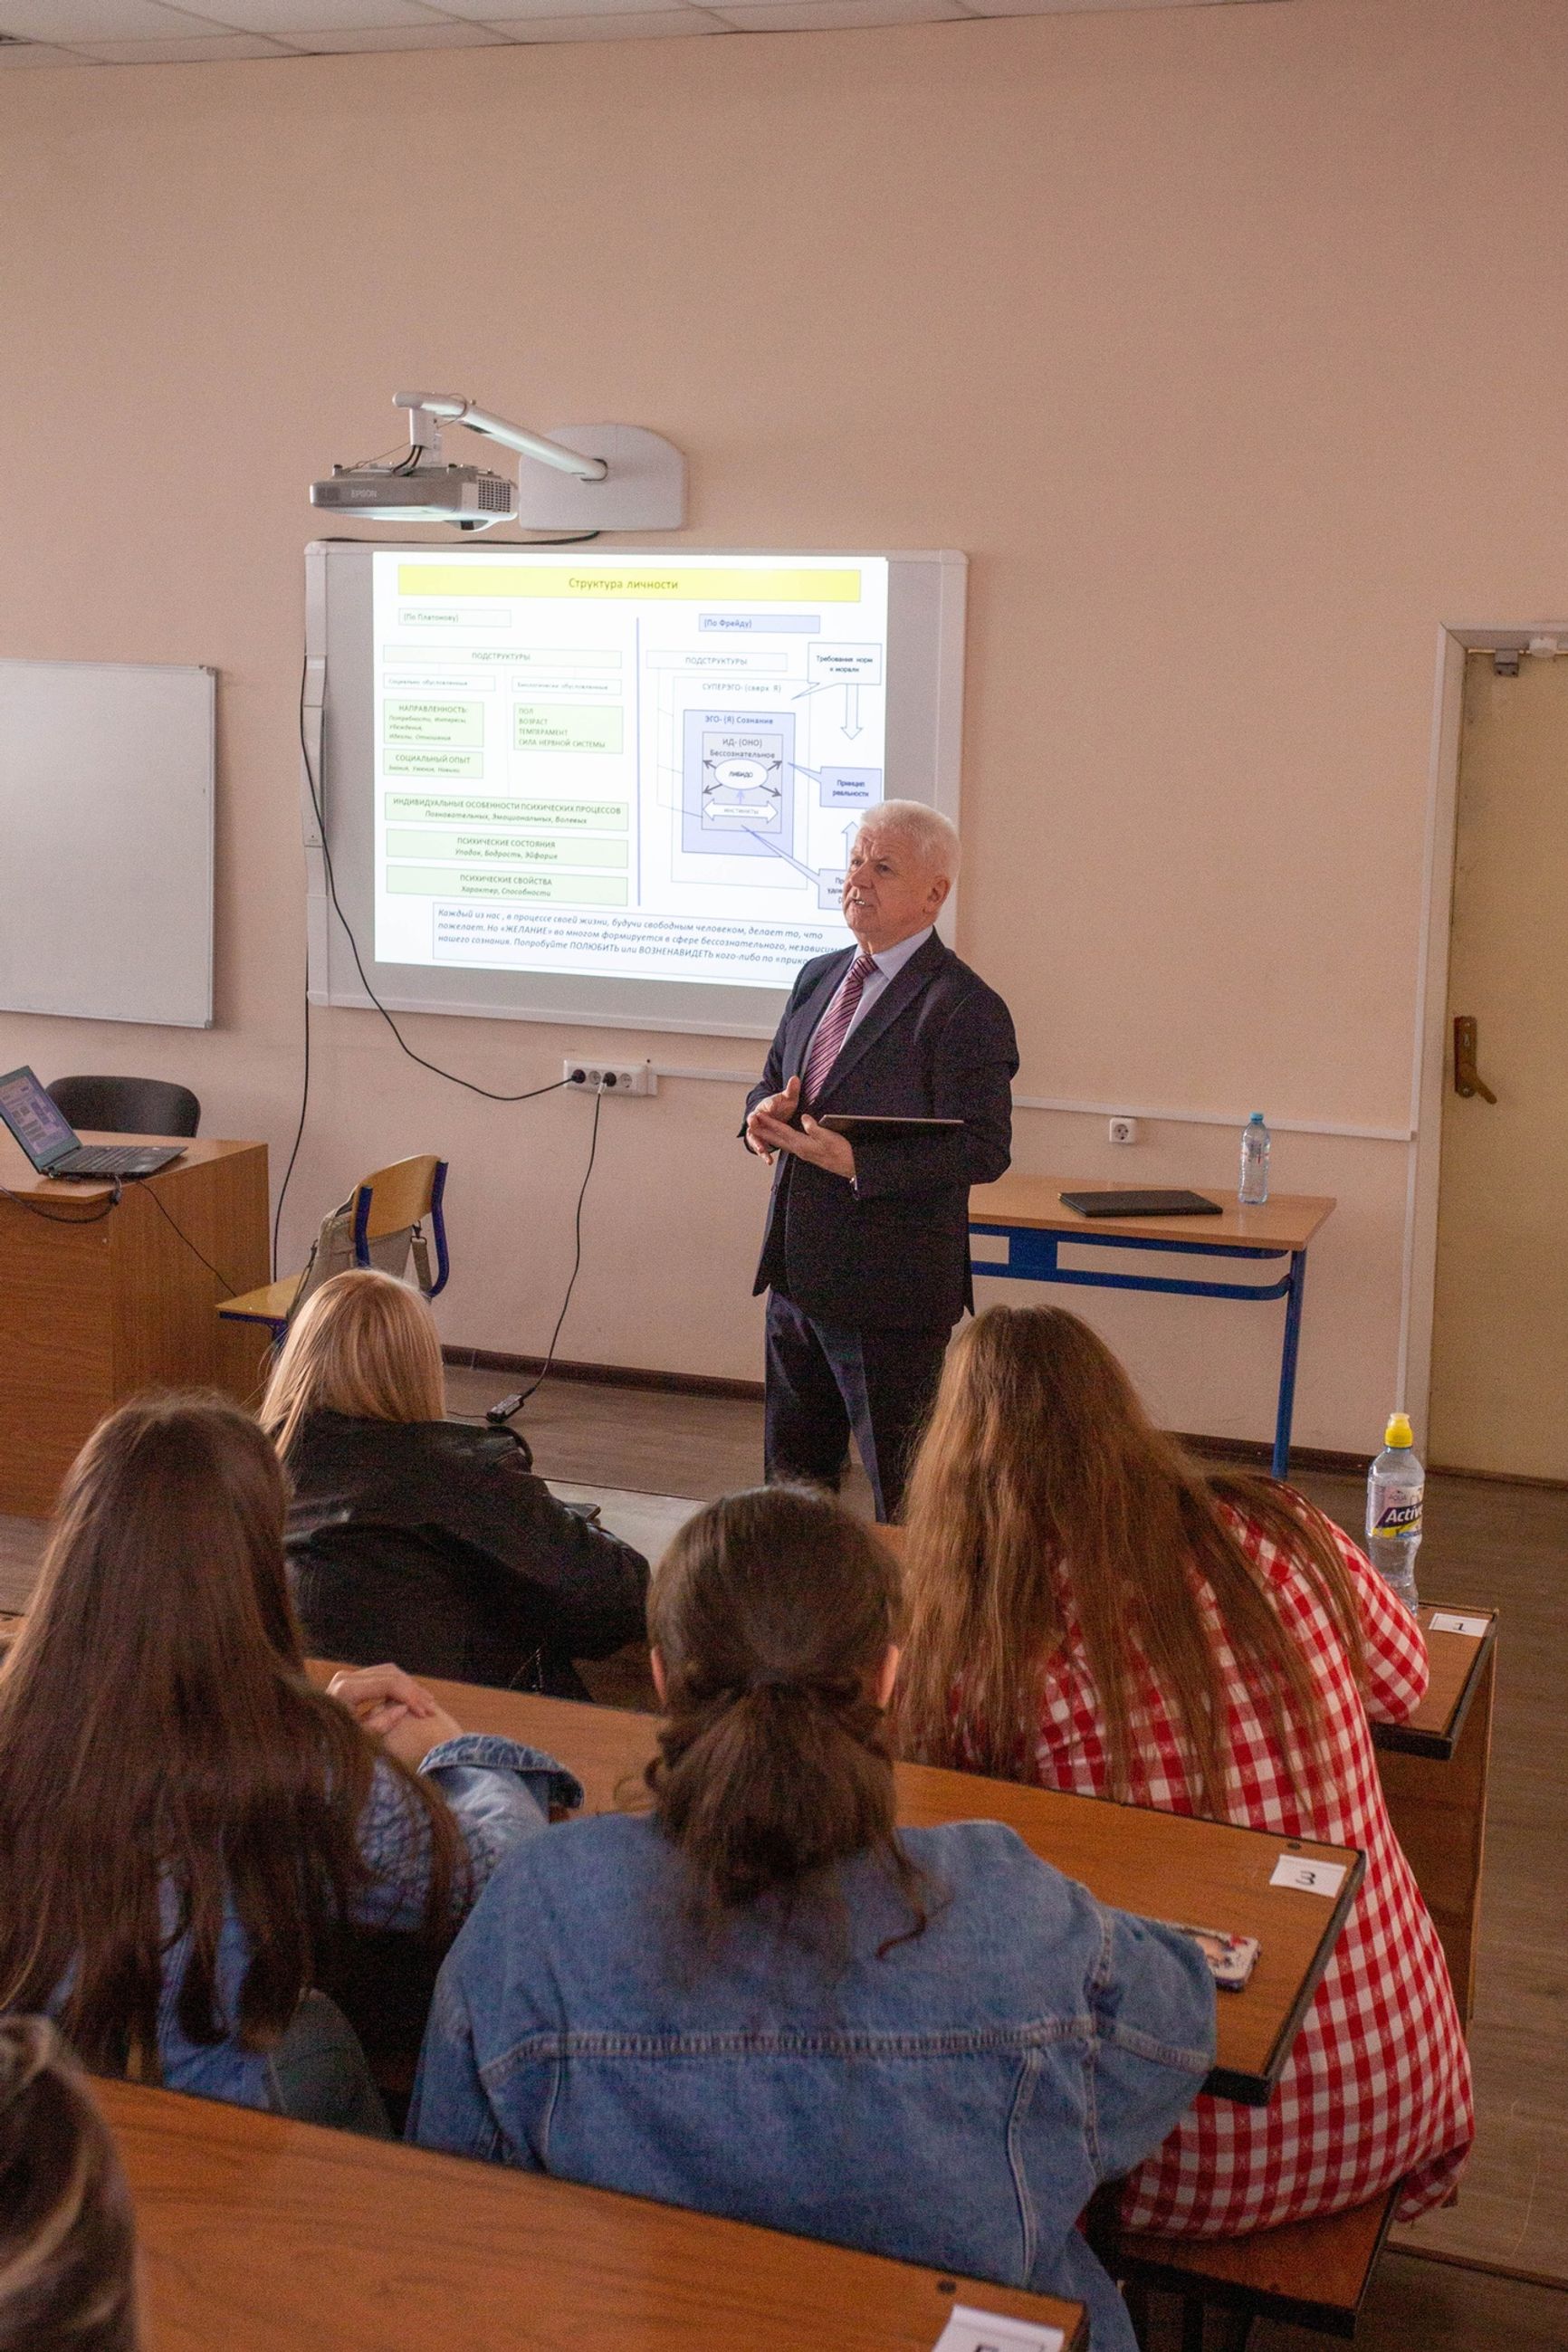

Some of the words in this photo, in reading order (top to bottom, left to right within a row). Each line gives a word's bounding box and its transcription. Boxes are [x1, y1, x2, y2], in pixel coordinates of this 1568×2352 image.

[351, 489, 377, 498] EPSON
[569, 578, 623, 590] Структура
[626, 580, 679, 589] личности
[703, 618, 718, 628] (По
[719, 618, 752, 629] Фрейду)
[472, 652, 531, 661] ПОДСТРУКТУРЫ
[685, 656, 748, 665] ПОДСТРУКТУРЫ
[817, 655, 854, 664] Требования
[736, 716, 773, 725] Сознание
[519, 728, 568, 736] ТЕМПЕРАМЕНТ
[519, 739, 537, 747] СИЛА
[539, 739, 570, 747] НЕРВНОЙ
[572, 741, 606, 749] СИСТЕМЫ
[396, 754, 448, 764] СОЦИАЛЬНЫЙ
[450, 756, 471, 764] ОПЫТ
[710, 750, 775, 760] Бессознательное
[837, 779, 865, 788] Принцип
[832, 789, 869, 798] реальности
[393, 798, 464, 808] ИНДИВИДУАЛЬНЫЕ
[465, 800, 520, 810] ОСОБЕННОСТИ
[521, 803, 574, 812] ПСИХИЧЕСКИХ
[576, 806, 621, 815] ПРОЦЕССОВ
[457, 837, 509, 846] ПСИХИЧЕСКИЕ
[511, 839, 556, 848] СОСТОЯНИЯ
[460, 875, 512, 884] ПСИХИЧЕСКИЕ
[513, 875, 552, 885] СВОЙСТВА
[438, 909, 473, 918] Каждый
[513, 914, 552, 923] процессе
[553, 913, 578, 923] своей
[579, 918, 610, 927] жизни,
[612, 917, 642, 929] будучи
[644, 921, 693, 931] свободным
[696, 924, 747, 935] человеком,
[749, 925, 784, 936] делает
[786, 930, 801, 938] то,
[803, 932, 823, 940] что
[438, 922, 486, 932] пожелает.
[487, 924, 499, 932] Но
[501, 925, 552, 935] «ЖЕЛАНИЕ»
[566, 930, 599, 939] многом
[601, 931, 663, 944] формируется
[672, 935, 699, 946] сфере
[701, 938, 788, 951] бессознательного,
[438, 935, 470, 944] нашего
[472, 938, 512, 946] сознания.
[514, 939, 568, 951] Попробуйте
[569, 942, 620, 952] ПОЛЮБИТЬ
[621, 946, 637, 954] или
[638, 946, 713, 959] ВОЗНЕНАВИДЕТЬ
[715, 951, 760, 961] кого-либо
[1296, 1870, 1315, 1885] 3
